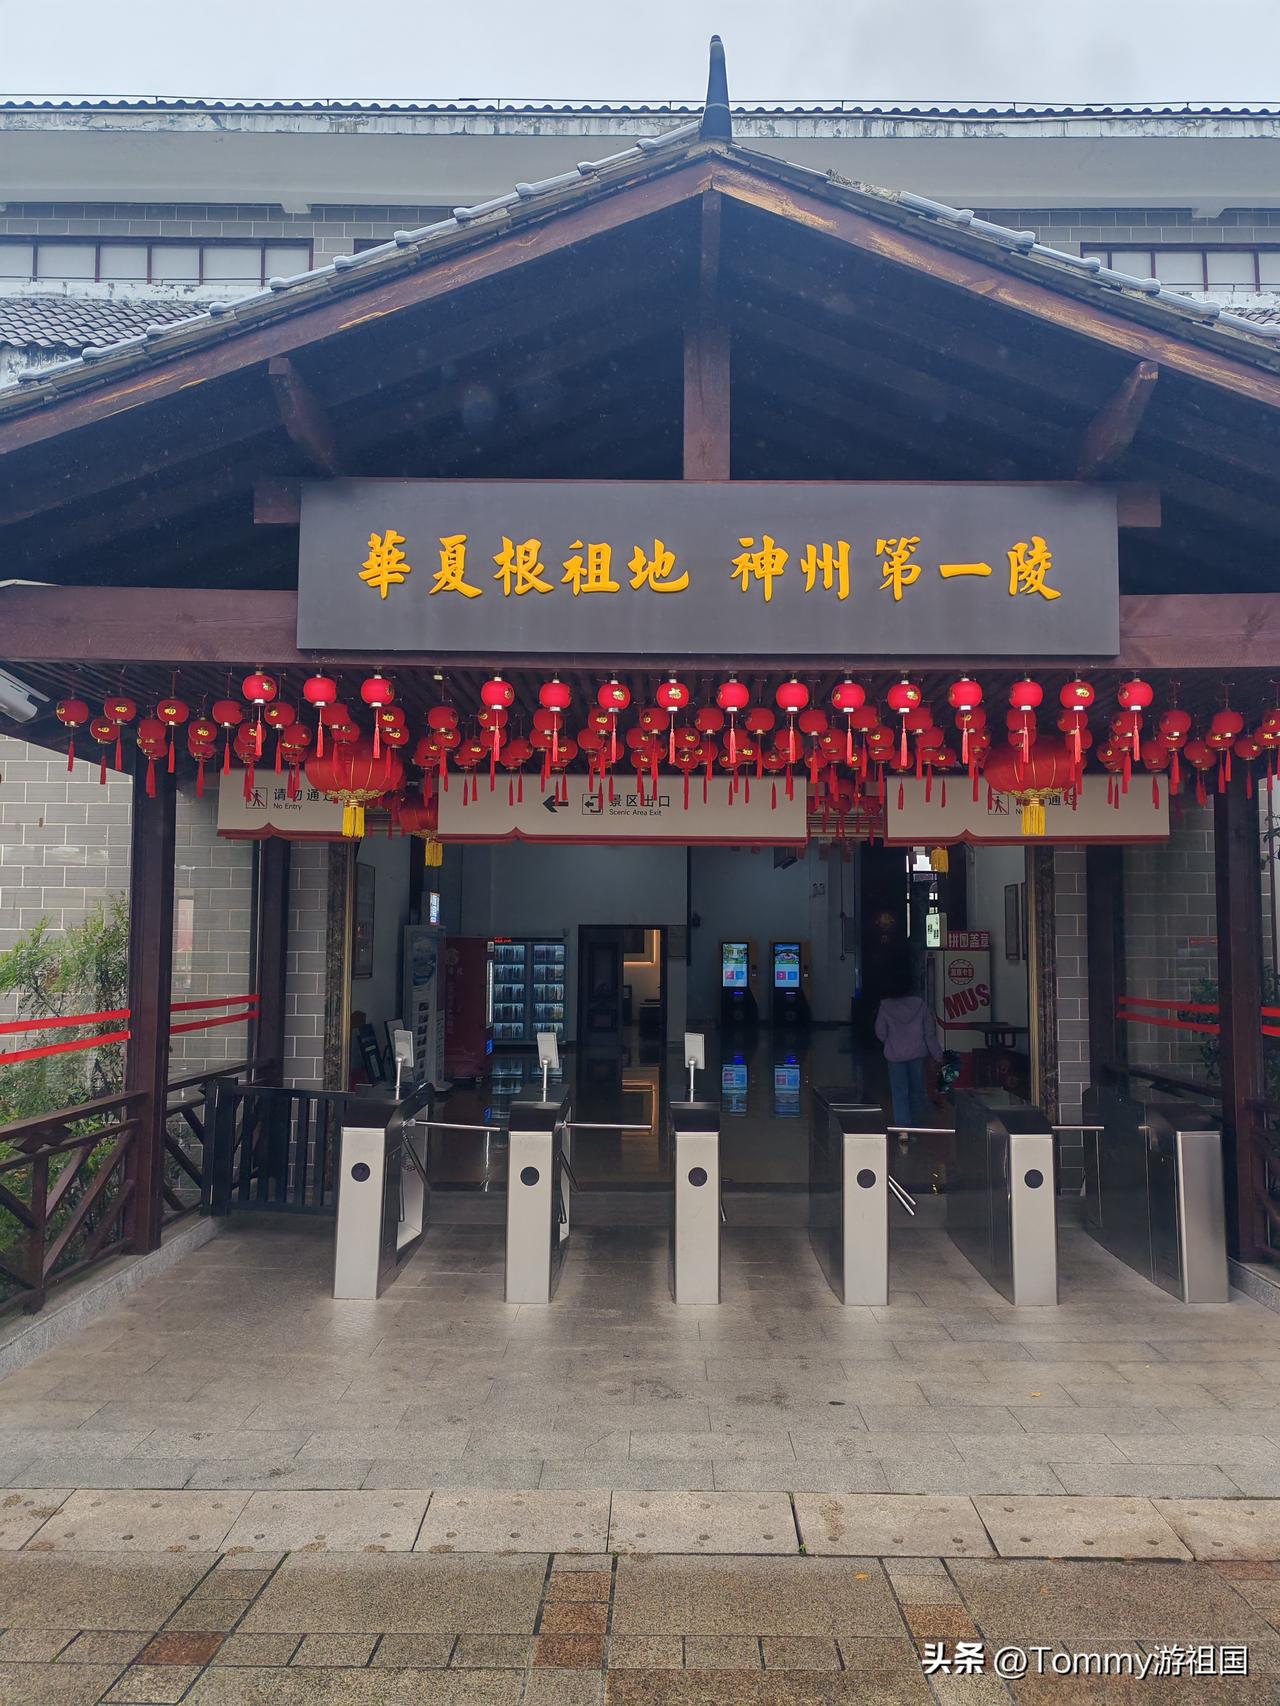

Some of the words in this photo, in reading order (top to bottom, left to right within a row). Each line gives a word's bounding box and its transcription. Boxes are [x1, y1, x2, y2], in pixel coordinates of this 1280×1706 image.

[358, 530, 690, 599] 華夏根祖地
[731, 535, 1061, 601] 神州第一陵
[284, 803, 303, 811] Entry
[609, 794, 670, 807] 景区出口
